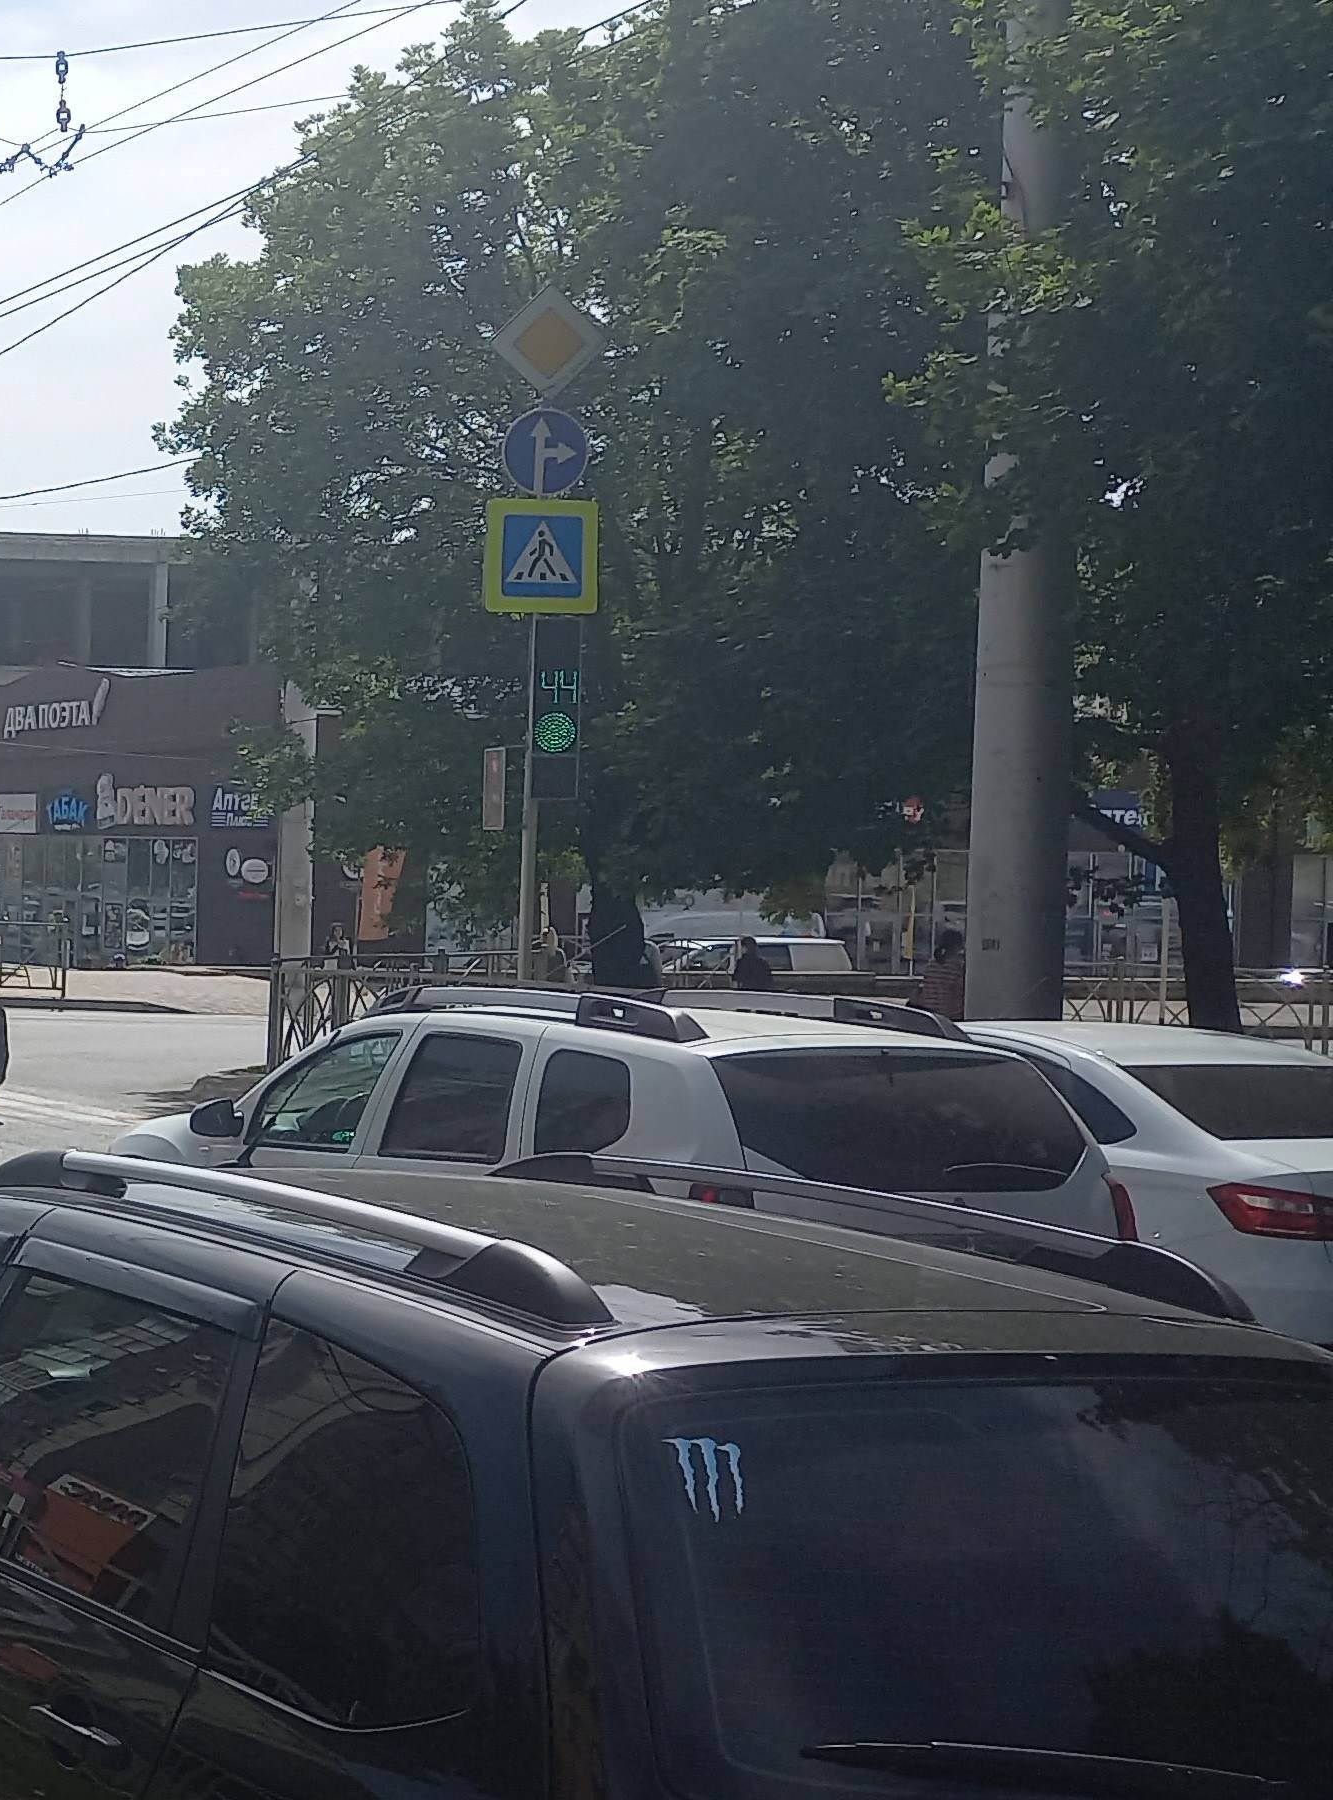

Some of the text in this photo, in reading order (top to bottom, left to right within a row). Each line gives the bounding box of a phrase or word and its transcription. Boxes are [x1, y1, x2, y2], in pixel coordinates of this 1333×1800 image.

[541, 670, 578, 703] 44
[3, 700, 90, 739] ДВА ПОЭТА
[46, 797, 90, 827] ТАБАК
